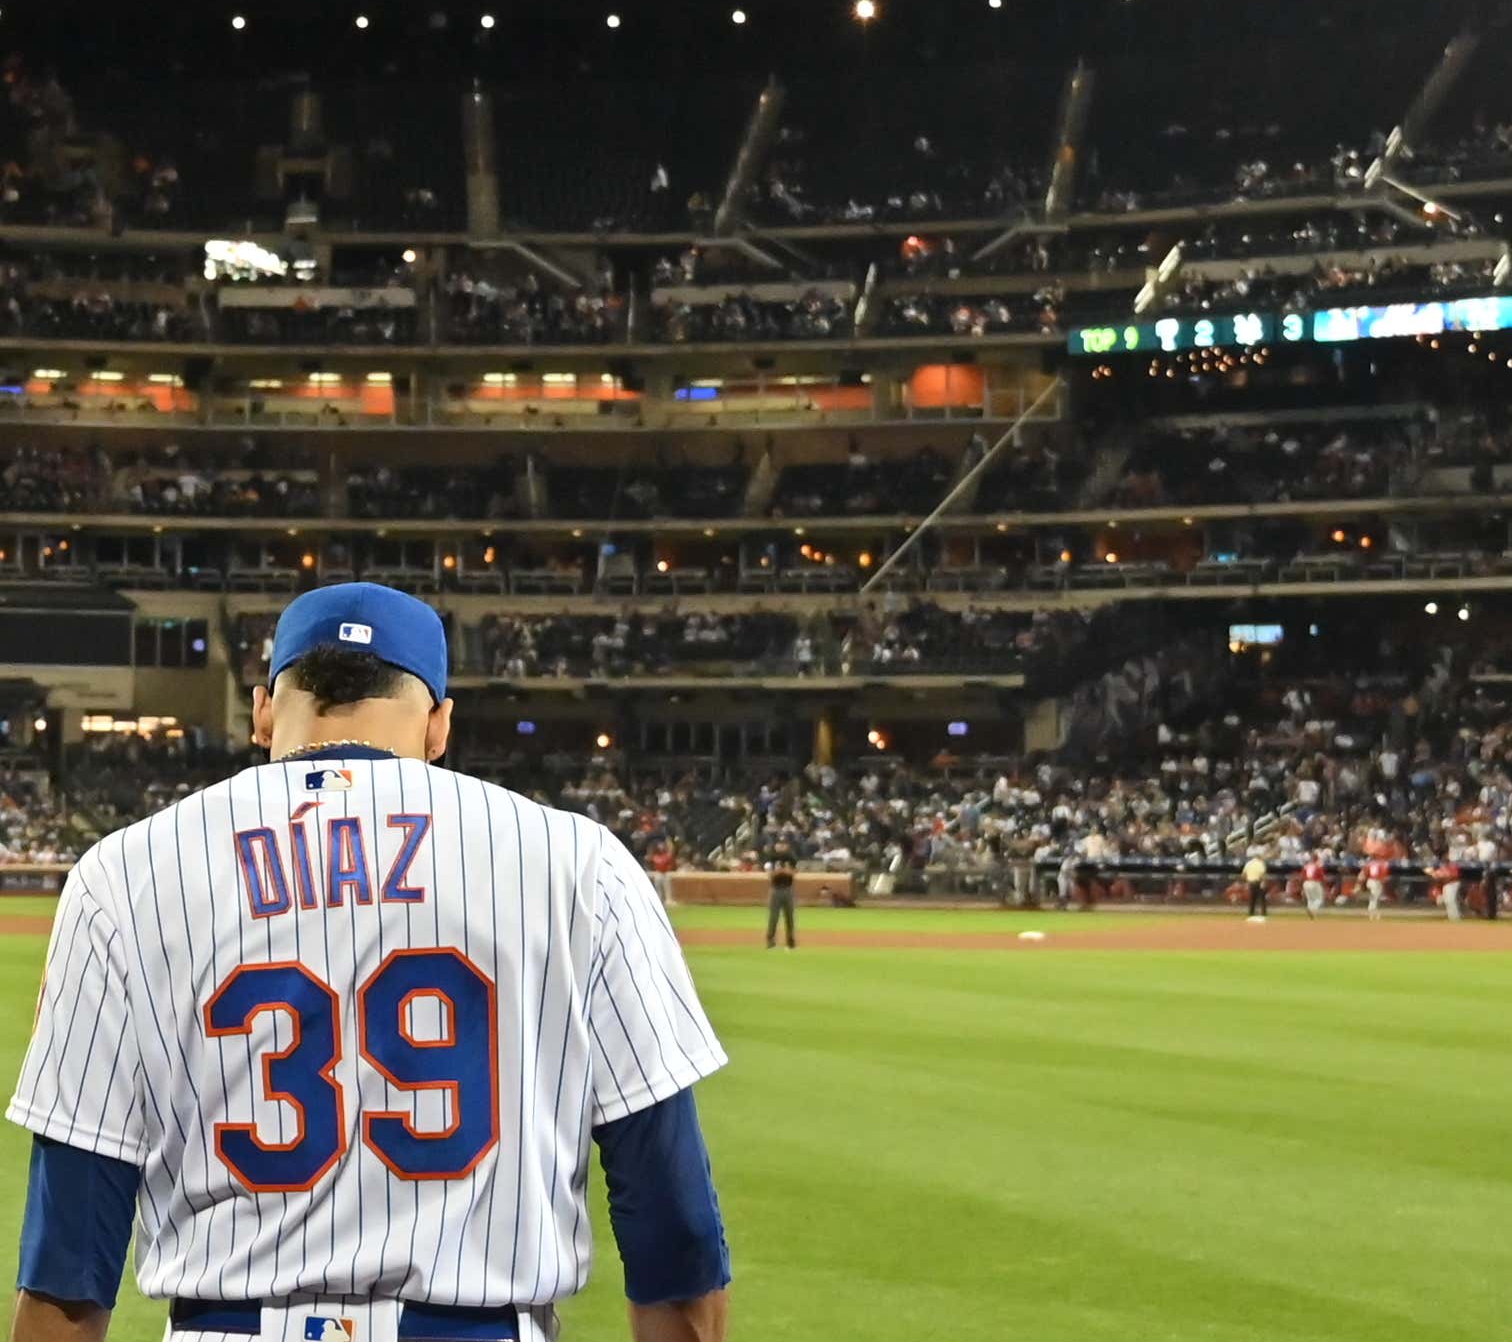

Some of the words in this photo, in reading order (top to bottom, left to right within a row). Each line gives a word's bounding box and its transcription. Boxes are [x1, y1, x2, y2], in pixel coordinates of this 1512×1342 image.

[1080, 327, 1117, 353] TOP
[1194, 319, 1214, 346] 2
[1282, 314, 1303, 340] 3
[234, 801, 432, 920] DÍAZ
[204, 946, 501, 1193] 39
